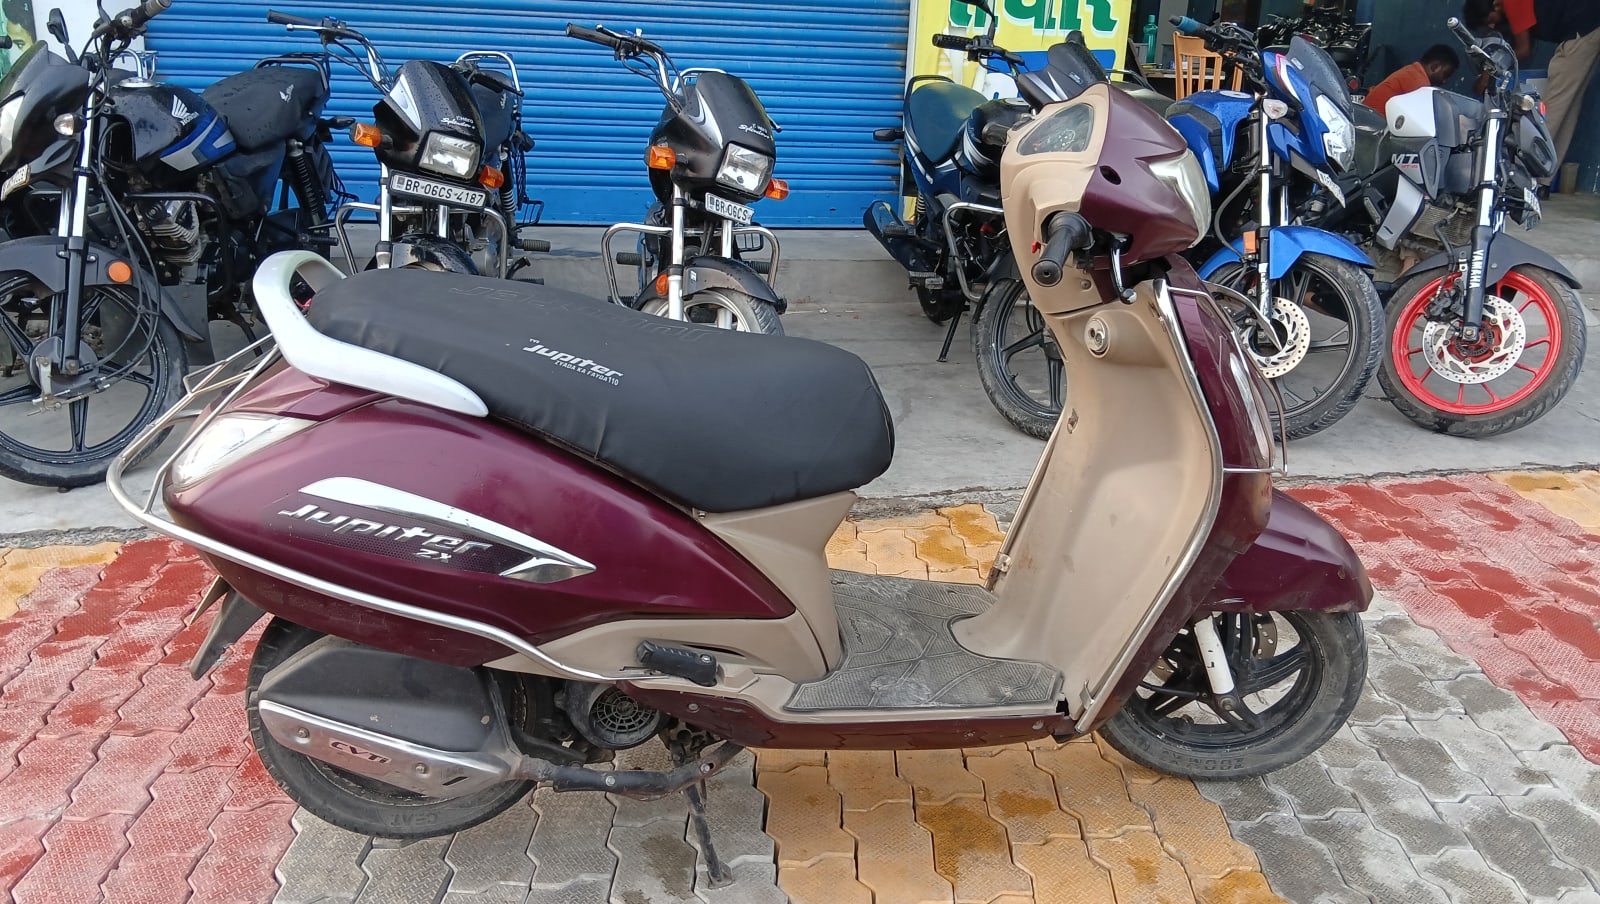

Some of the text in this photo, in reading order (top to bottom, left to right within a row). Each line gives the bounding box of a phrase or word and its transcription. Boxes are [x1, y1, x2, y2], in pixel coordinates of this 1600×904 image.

[1391, 153, 1419, 165] MT
[1469, 249, 1484, 289] YAMAHA
[523, 344, 624, 376] Jupiter
[554, 360, 576, 371] ZYADA
[577, 366, 587, 374] KA
[277, 503, 494, 553] Jupiter
